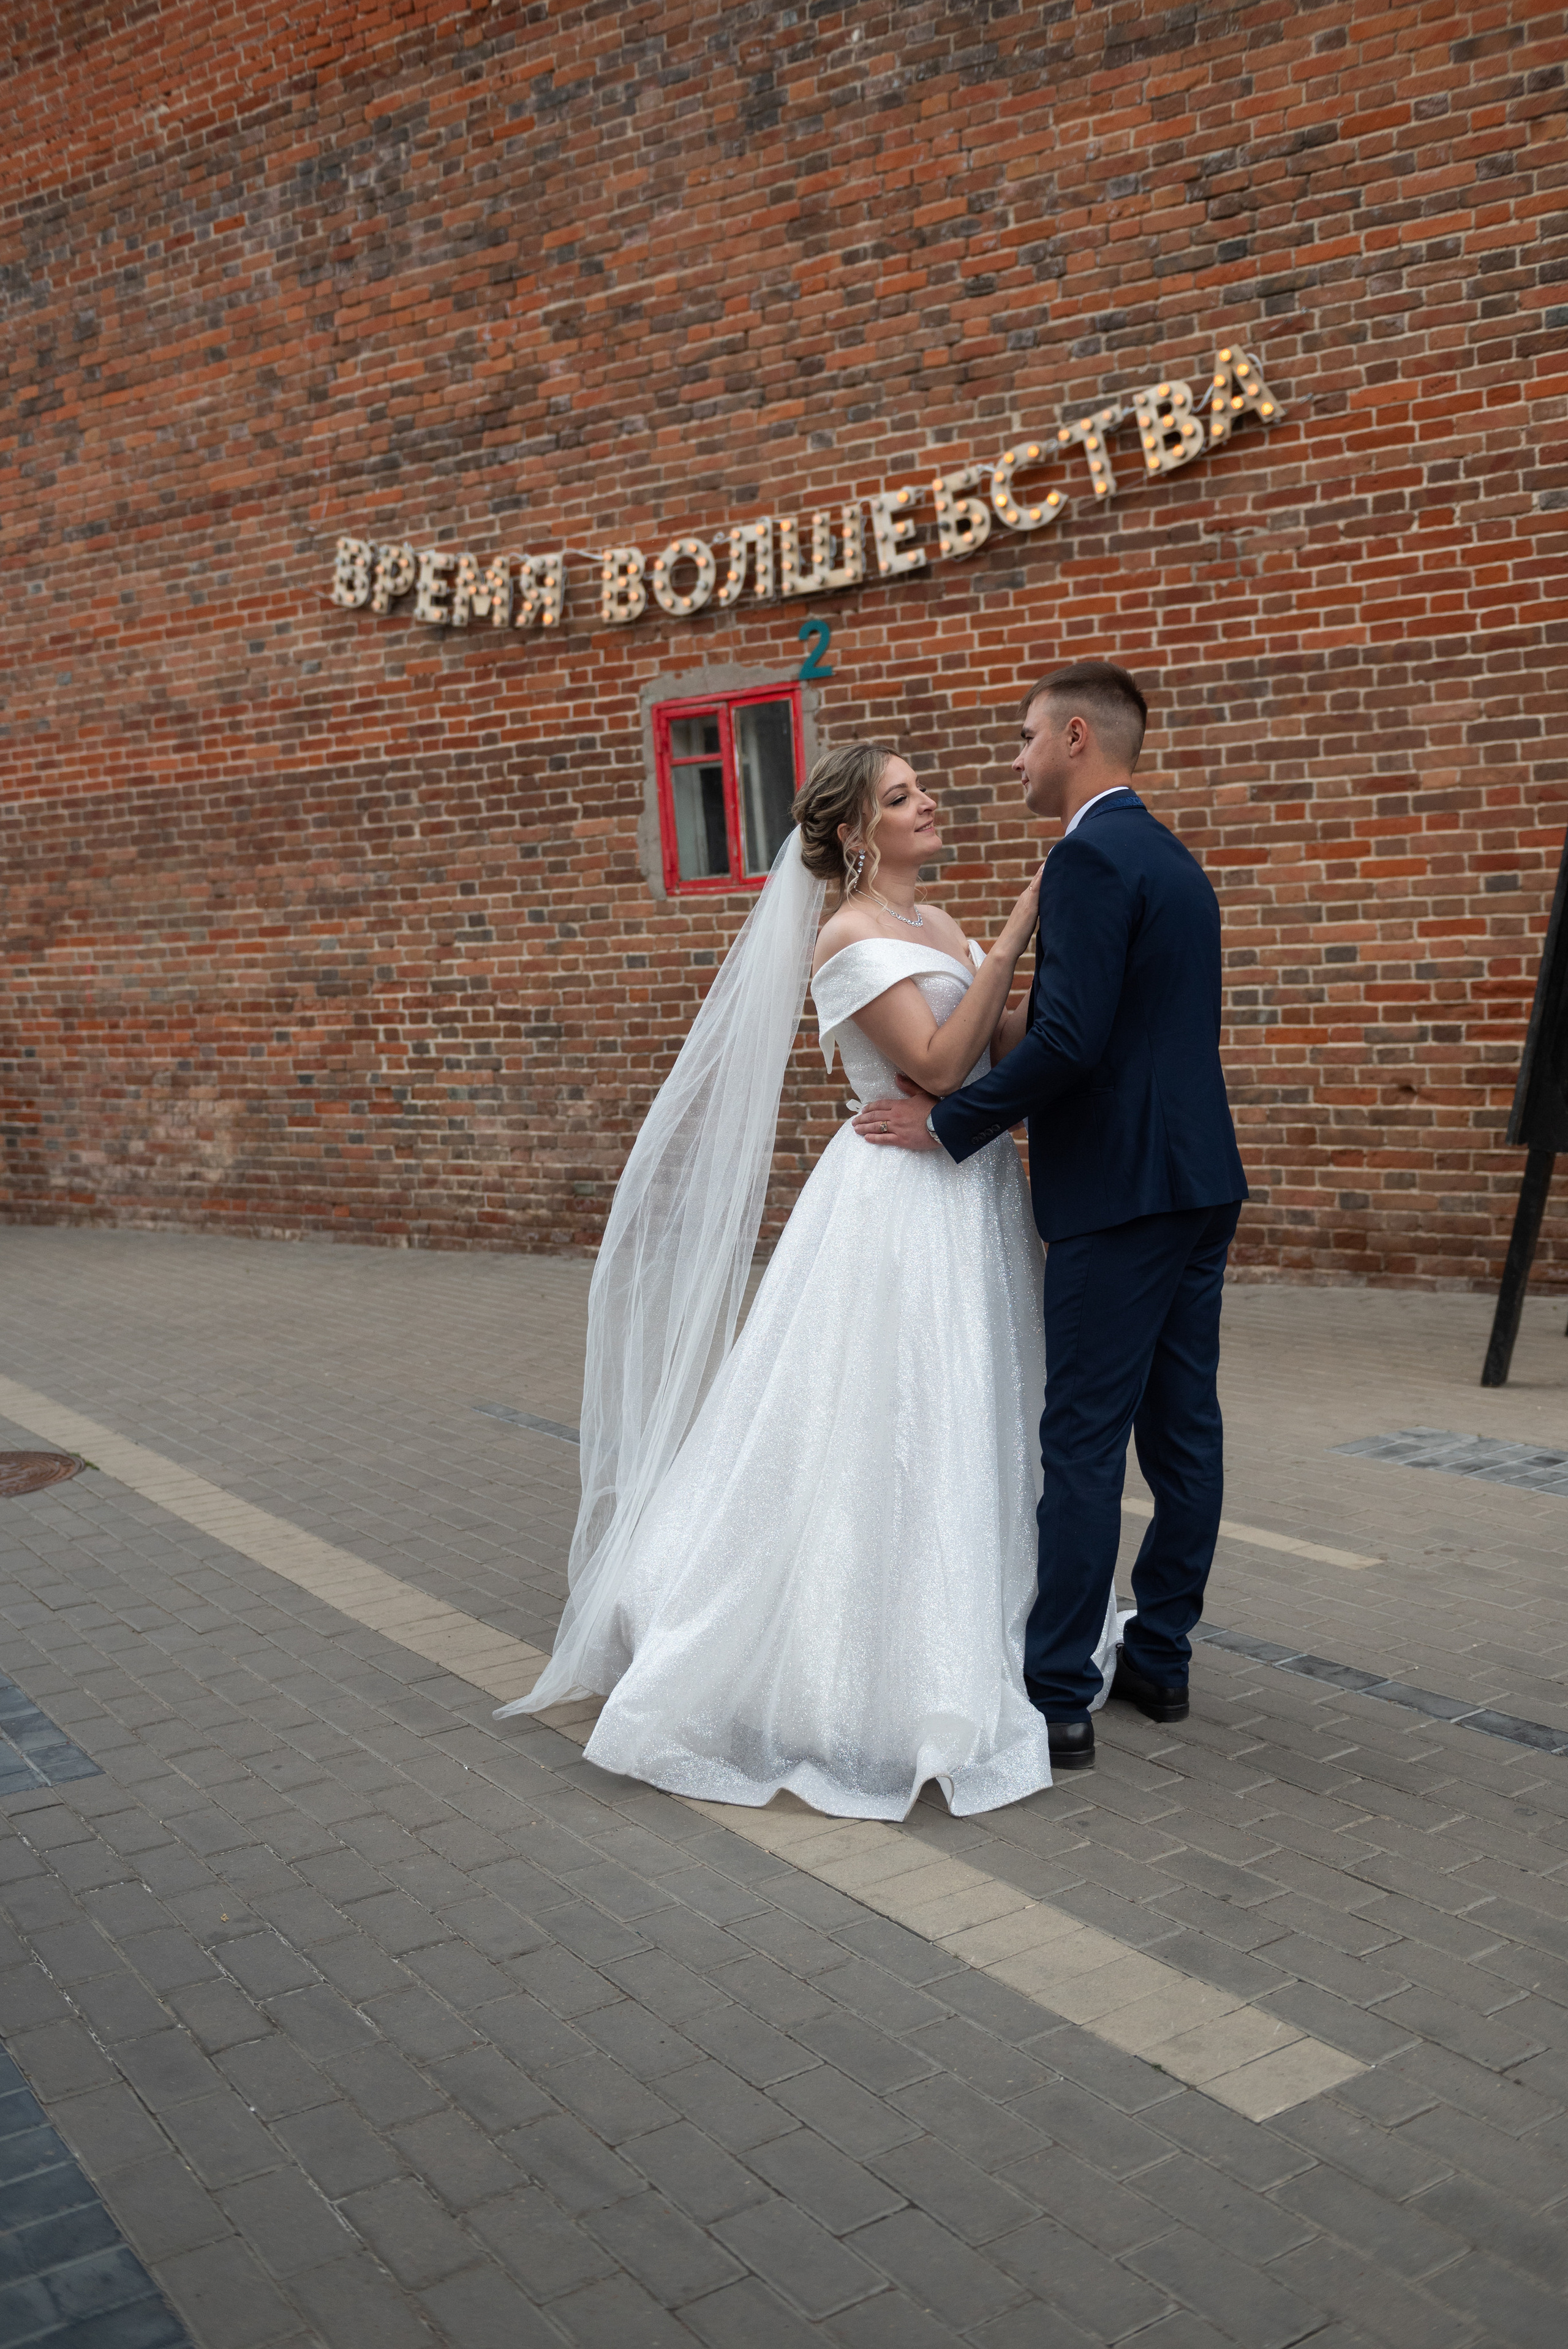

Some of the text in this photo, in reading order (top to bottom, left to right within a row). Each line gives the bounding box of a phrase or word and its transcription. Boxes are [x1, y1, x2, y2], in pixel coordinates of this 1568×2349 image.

[331, 344, 1286, 627] ВРЕМЯ ВОЛШЕБСТВА
[798, 619, 833, 680] 2
